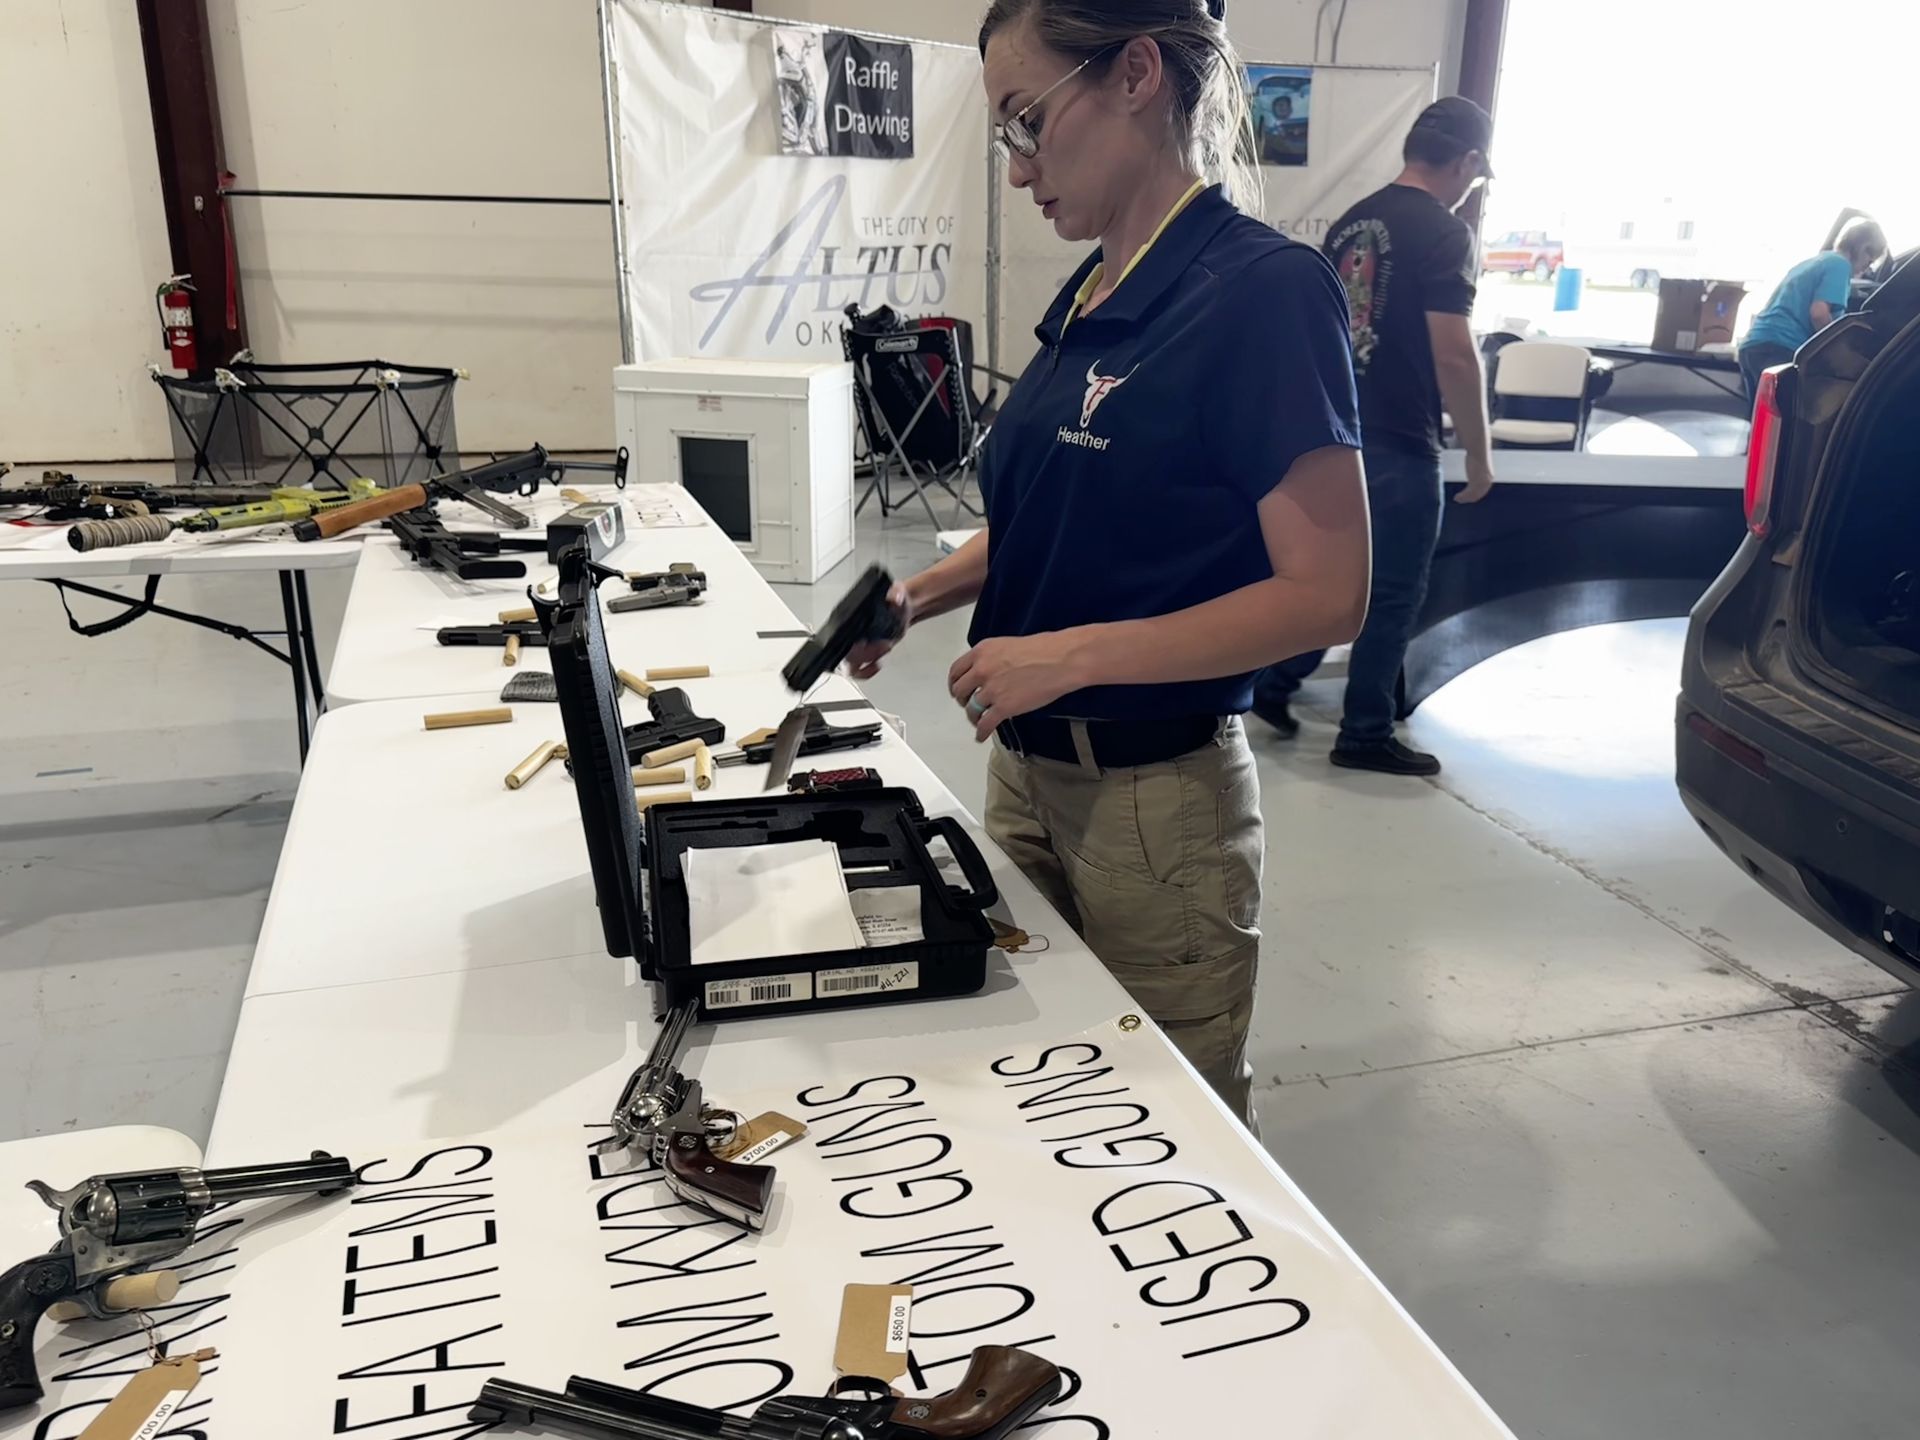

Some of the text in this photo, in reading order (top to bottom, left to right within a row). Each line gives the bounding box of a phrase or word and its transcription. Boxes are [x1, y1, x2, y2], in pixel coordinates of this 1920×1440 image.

[845, 56, 899, 90] Raffle
[834, 104, 910, 142] Drawing
[861, 216, 955, 236] THE CITY OF
[689, 174, 953, 350] ALTUS
[1056, 426, 1111, 451] Heather
[741, 1137, 779, 1162] $700.00
[796, 1075, 973, 1219] GUNS
[990, 1043, 1310, 1359] USED GUNS
[341, 1145, 501, 1327] ITEMS
[890, 1305, 906, 1342] $650.00
